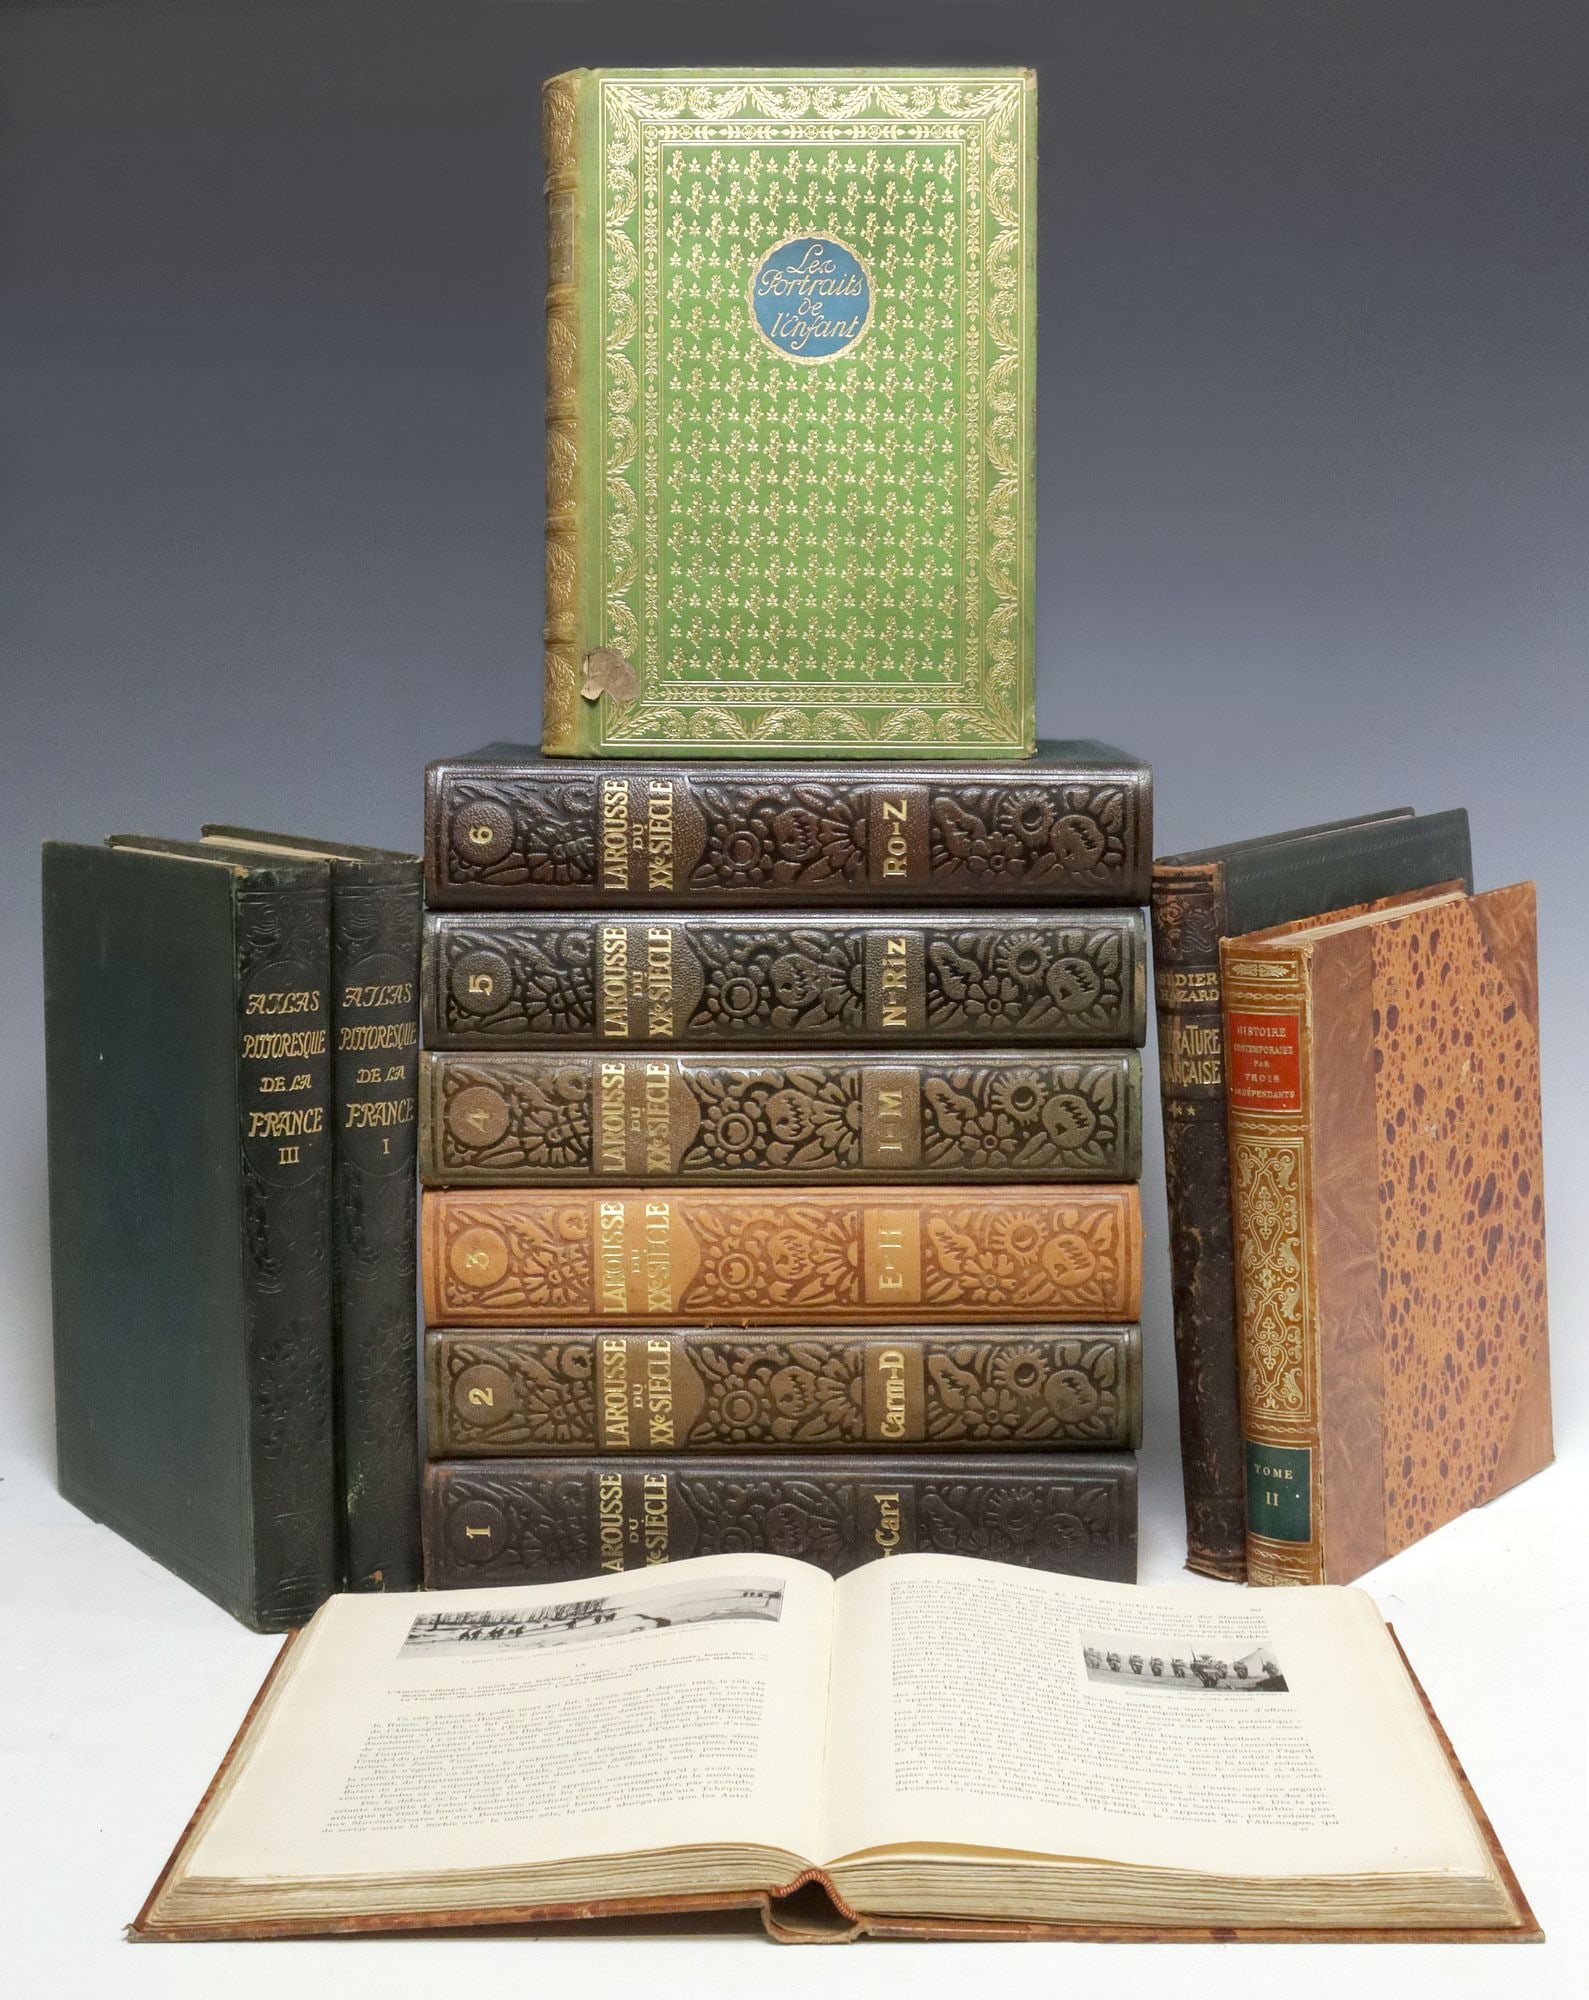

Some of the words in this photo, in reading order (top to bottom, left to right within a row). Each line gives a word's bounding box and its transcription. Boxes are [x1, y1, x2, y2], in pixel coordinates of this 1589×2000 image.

[786, 244, 836, 274] Les
[757, 269, 863, 296] Portraits
[798, 297, 823, 316] de
[770, 312, 859, 350] l'Enfant
[469, 825, 493, 844] 6
[603, 779, 628, 891] LAROUSSE
[632, 823, 643, 850] DU
[343, 982, 412, 1007] ATLAS
[469, 974, 493, 996] 5
[603, 927, 628, 1038] LAROUSSE
[632, 971, 643, 997] DU
[245, 990, 320, 1015] ATLAS
[242, 1029, 326, 1059] PITTORESQUE
[339, 1021, 417, 1050] PITTORESQUE
[1236, 1026, 1287, 1037] HISTOIRE
[357, 1068, 382, 1084] DE
[384, 1065, 405, 1082] LA
[1253, 1060, 1270, 1068] PAR
[260, 1077, 286, 1093] DE
[289, 1074, 312, 1091] LA
[1244, 1073, 1280, 1083] TROIS
[248, 1107, 323, 1137] FRANCE
[346, 1098, 414, 1128] FRANCE
[466, 1111, 490, 1132] 4
[601, 1062, 626, 1172] LAROUSSE
[631, 1106, 640, 1131] DU
[278, 1146, 299, 1165] III
[382, 1138, 390, 1155] I
[601, 1202, 627, 1313] LAROUSSE
[468, 1387, 493, 1407] 2
[603, 1339, 630, 1447] LAROUSSE
[633, 1383, 644, 1408] DU
[1254, 1464, 1293, 1480] TOME
[1266, 1491, 1279, 1507] II
[466, 1525, 491, 1539] 1
[600, 1473, 625, 1572] AROUSSE
[629, 1518, 639, 1543] DU
